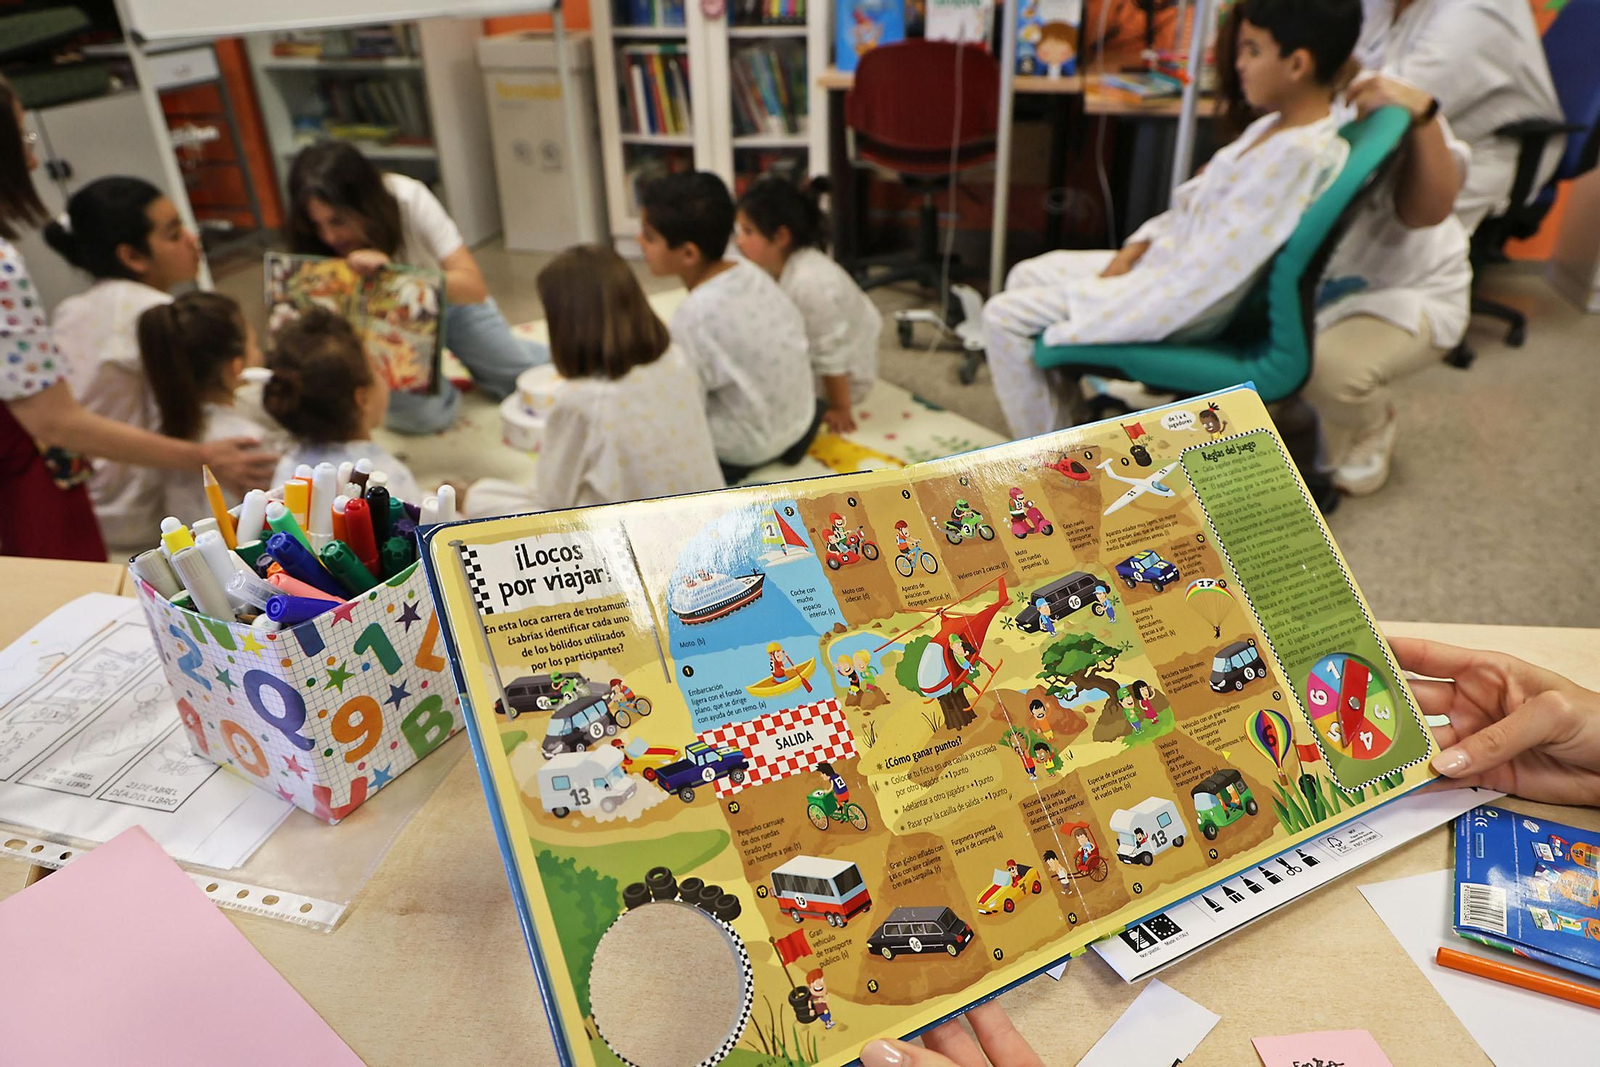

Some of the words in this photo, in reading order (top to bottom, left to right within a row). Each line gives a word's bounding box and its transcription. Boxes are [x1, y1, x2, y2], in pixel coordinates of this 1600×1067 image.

[1168, 418, 1192, 430] jugadores
[1202, 448, 1224, 463] Reglas
[1226, 445, 1236, 456] del
[1236, 440, 1256, 454] juego
[964, 526, 970, 534] 3
[514, 544, 584, 571] ¡Locos
[1028, 554, 1042, 562] ruedas
[498, 578, 536, 606] por
[543, 557, 612, 595] viajar!
[957, 572, 972, 580] Velero
[974, 568, 982, 576] con
[842, 588, 856, 596] Moto
[902, 584, 918, 592] Aparato
[1198, 580, 1214, 588] 17
[797, 596, 814, 604] mucho
[803, 603, 822, 612] espacio
[908, 598, 928, 608] despegue
[1070, 598, 1080, 608] 16
[484, 625, 496, 634] En
[498, 620, 518, 632] esta
[519, 617, 538, 628] loca
[540, 612, 572, 624] carrera
[574, 608, 584, 618] de
[586, 598, 630, 616] trotamund
[508, 630, 544, 646] ¿sabrías
[545, 622, 590, 638] identificar
[592, 617, 612, 628] cada
[614, 615, 630, 624] uno
[1142, 628, 1156, 638] gracias
[521, 648, 533, 658] de
[535, 644, 549, 655] los
[550, 639, 583, 652] bólidos
[584, 629, 626, 645] utilizados
[680, 640, 696, 649] Moto.
[1144, 636, 1157, 644] techo
[354, 622, 402, 676] 1
[169, 624, 212, 692] 2
[531, 662, 547, 674] por
[548, 657, 563, 668] los
[564, 643, 624, 667] participantes?
[1161, 670, 1180, 680] Bicicleta
[1180, 666, 1190, 674] todo
[1326, 660, 1342, 680] 1
[688, 684, 724, 697] Embarcación
[691, 696, 708, 706] ligera
[725, 688, 742, 698] fondo
[243, 669, 316, 752] Q
[694, 705, 712, 716] plano,
[713, 704, 724, 712] que
[732, 697, 747, 706] dirige
[709, 712, 726, 722] ayuda
[726, 710, 735, 718] de
[742, 704, 758, 713] remo.
[1222, 704, 1240, 715] maletero
[1374, 704, 1390, 720] 3
[331, 695, 384, 764] 9
[401, 694, 454, 759] B
[592, 724, 601, 736] 8
[1326, 722, 1342, 744] 5
[775, 730, 815, 751] SALIDA
[1262, 724, 1276, 748] 6
[1359, 731, 1373, 751] 4
[885, 754, 912, 770] ¿Cómo
[912, 748, 934, 761] ganar
[934, 736, 963, 756] puntos?
[890, 772, 913, 785] Colocar
[914, 770, 920, 778] tu
[920, 765, 934, 775] ficha
[942, 760, 952, 768] una
[952, 754, 969, 765] casilla
[976, 744, 998, 758] ocupada
[704, 770, 712, 780] 4
[838, 777, 844, 788] 2
[896, 790, 906, 798] por
[907, 785, 920, 794] otro
[920, 777, 940, 790] jugador
[953, 766, 969, 777] punto
[1087, 774, 1105, 786] Especie
[1100, 778, 1118, 790] permite
[1117, 770, 1138, 784] practicar
[147, 795, 178, 806] LIBRO
[570, 788, 592, 806] 13
[902, 799, 928, 813] Adelantar
[934, 792, 946, 801] otro
[946, 785, 966, 798] jugador
[978, 774, 994, 786] punto
[1099, 790, 1112, 799] vuelo
[730, 803, 738, 812] 20
[907, 820, 922, 830] Pasar
[923, 816, 934, 824] por
[940, 807, 957, 818] casilla
[957, 804, 965, 812] de
[965, 798, 980, 808] salida
[992, 788, 1008, 798] punto
[737, 824, 762, 838] Pequeño
[762, 817, 786, 830] carruaje
[951, 833, 974, 847] Furgoneta
[974, 824, 997, 839] preparada
[740, 838, 749, 847] de
[750, 835, 760, 844] dos
[760, 830, 780, 840] ruedas
[1150, 830, 1168, 848] 13
[744, 846, 762, 856] tirado
[762, 842, 772, 851] por
[902, 854, 917, 866] globo
[934, 844, 944, 852] con
[954, 846, 966, 856] para
[746, 858, 756, 866] un
[756, 850, 778, 863] hombre
[1020, 882, 1026, 894] 7
[808, 929, 823, 938] Gran
[824, 938, 852, 956] transporte
[910, 940, 920, 950] 16
